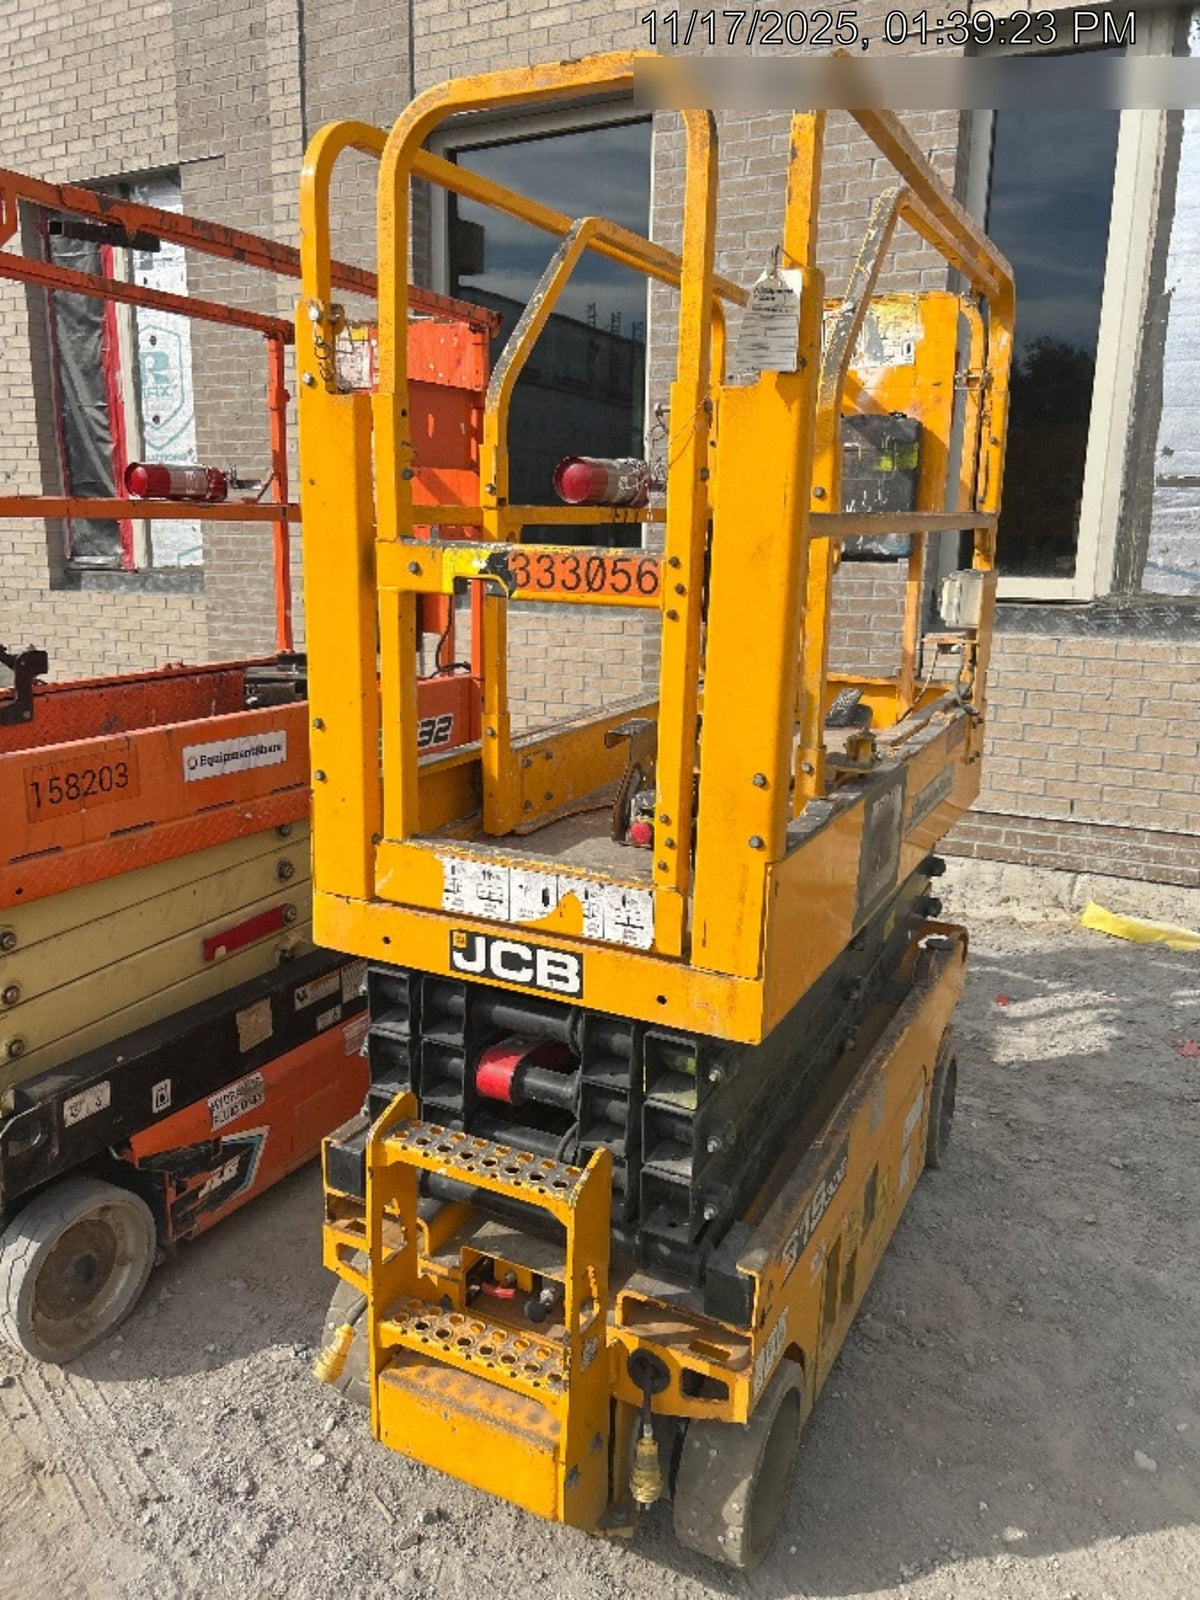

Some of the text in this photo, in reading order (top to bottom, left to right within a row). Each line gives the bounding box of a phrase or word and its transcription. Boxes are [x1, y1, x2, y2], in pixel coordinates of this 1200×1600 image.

[511, 551, 659, 595] 333056
[417, 713, 453, 749] 32
[29, 761, 130, 809] 158203
[452, 935, 582, 994] JCB
